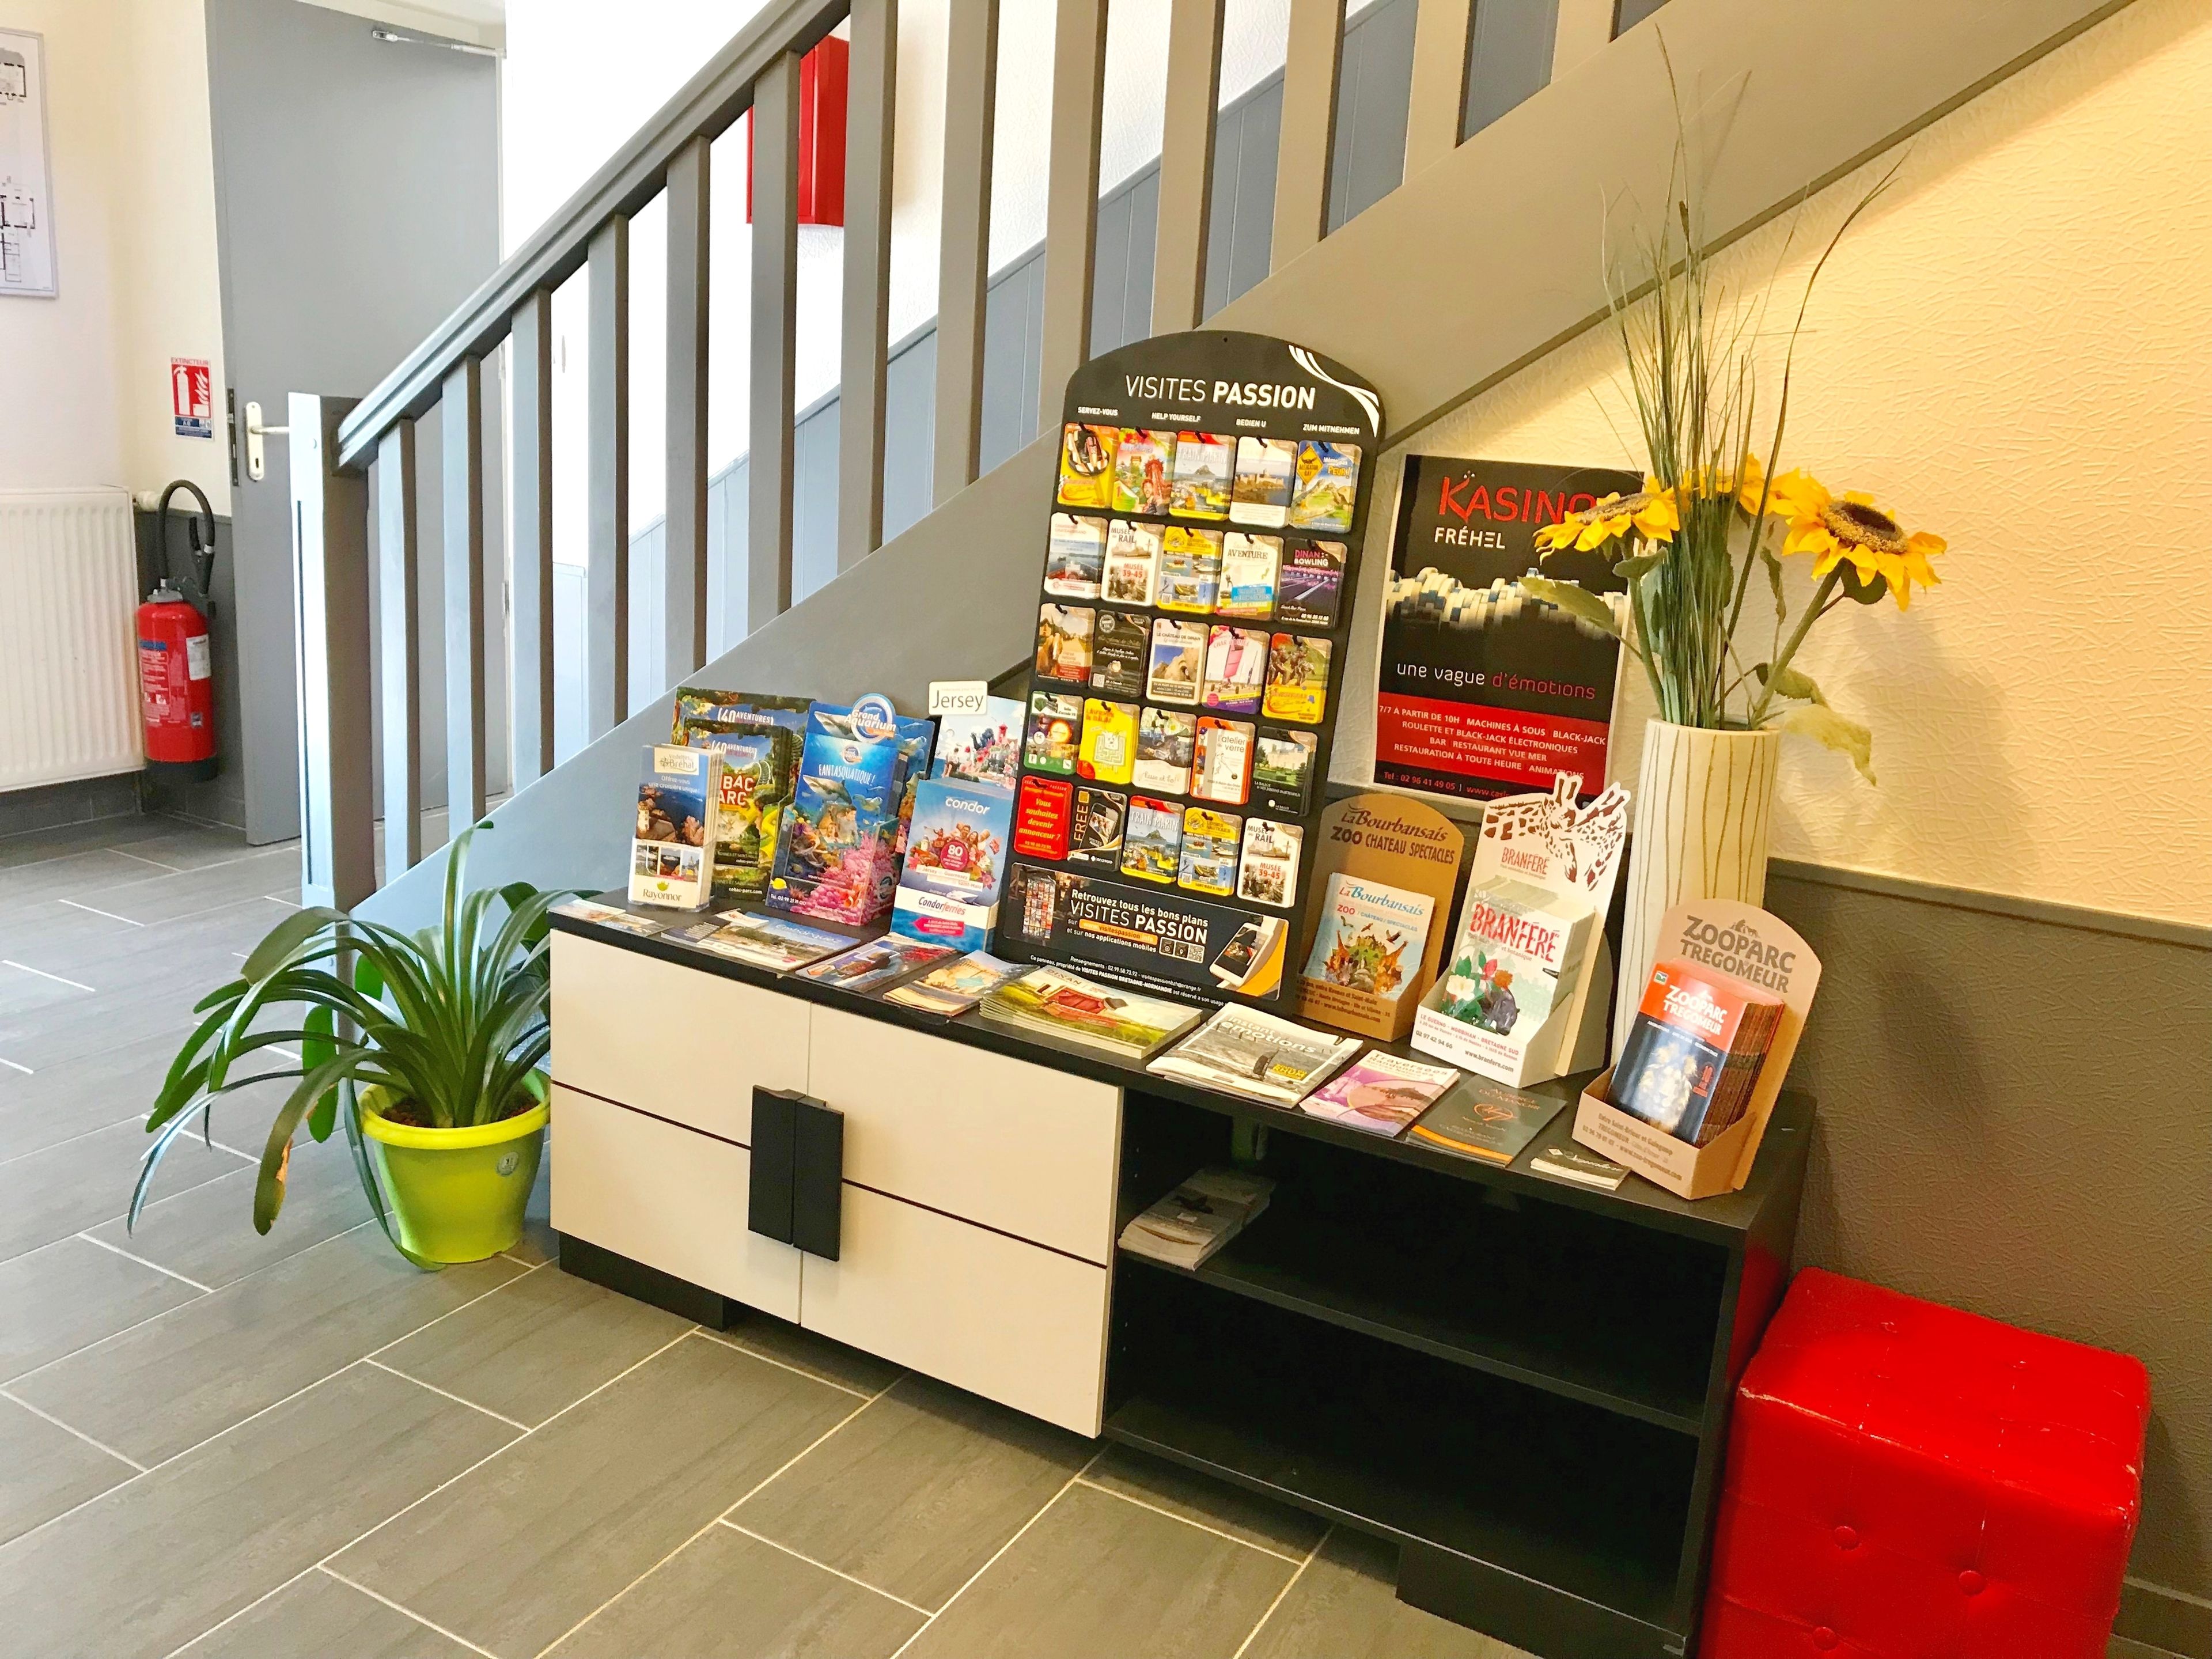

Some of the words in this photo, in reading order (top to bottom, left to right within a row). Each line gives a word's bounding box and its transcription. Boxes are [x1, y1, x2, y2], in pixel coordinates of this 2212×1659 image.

[171, 357, 209, 365] EXTINCTEUR
[1126, 374, 1206, 402] VISITES
[1213, 381, 1316, 410] PASSION
[1078, 406, 1118, 416] SERVEZ-VOUS
[1152, 412, 1168, 421] HELP
[1169, 413, 1201, 422] YOURSELF
[1236, 419, 1260, 427] BEDIEN
[1302, 423, 1318, 432] ZUM
[1319, 425, 1360, 435] MITNEHMEN
[1111, 527, 1131, 535] MUSÉE
[1118, 535, 1137, 543] RAIL
[1228, 549, 1268, 559] AVENTURE
[1295, 550, 1320, 558] DINAN
[1123, 562, 1143, 570] MUSÉE
[1294, 558, 1328, 566] BOWLING
[1123, 569, 1143, 578] 39-45
[1397, 662, 1427, 677] une
[1434, 668, 1485, 687] vague
[1492, 672, 1596, 700] d'émotions
[932, 690, 983, 712] Jersey
[852, 709, 880, 720] Grand
[844, 713, 896, 732] Aquarium
[1379, 705, 1392, 714] 7/7
[1402, 709, 1429, 719] PARTIR
[1431, 713, 1442, 721] DE
[1445, 715, 1460, 724] 10H
[1467, 718, 1510, 732] MACHINES
[1522, 726, 1546, 736] SOUS
[1553, 730, 1606, 745] BLACK-JACK
[1402, 721, 1442, 733] ROULETTE
[1456, 729, 1506, 743] BLACK-JACK
[1509, 736, 1578, 754] ÉLECTRONIQUES
[1225, 744, 1245, 753] verre
[1430, 737, 1446, 746] BAR
[1453, 741, 1506, 755] RESTAURANT
[1509, 749, 1525, 759] VUE
[1528, 752, 1547, 762] MER
[1394, 744, 1455, 759] RESTAURATION
[1465, 754, 1491, 765] TOUTE
[1494, 759, 1522, 770] HEURE
[723, 775, 754, 791] BAC
[719, 790, 747, 805] ARC
[1036, 798, 1051, 807] Vous
[945, 798, 990, 815] condor
[1025, 808, 1058, 819] souhaitez
[1028, 818, 1054, 829] devenir
[1074, 804, 1089, 842] FREE
[1131, 810, 1152, 825] TRAIN
[1155, 816, 1178, 831] MARIN
[1341, 812, 1354, 823] La
[1355, 809, 1448, 842] Bourbansais
[1018, 827, 1056, 839] annonceur
[1255, 833, 1272, 843] RAIL
[948, 844, 963, 857] 80
[1330, 825, 1362, 844] ZOO
[1365, 834, 1407, 854] CHATEAU
[1409, 841, 1455, 864] SPECTACLES
[1259, 869, 1280, 879] 39-45
[1260, 862, 1281, 872] MUSÉE
[643, 889, 682, 902] Rayonnor
[1339, 887, 1350, 896] La
[1350, 885, 1425, 916] Bourbansais
[918, 896, 966, 915] Condorferries
[1072, 889, 1117, 907] Retrouvez
[1119, 899, 1139, 912] tous
[1142, 904, 1156, 915] les
[1157, 907, 1180, 921] bons
[1182, 914, 1208, 927] plans
[1070, 900, 1130, 926] VISITES
[1135, 914, 1207, 944] PASSION
[1337, 904, 1355, 915] ZOO
[1387, 919, 1418, 932] SPECTACLES
[1470, 903, 1560, 963] BRANFÉRÉ
[1096, 934, 1131, 948] applications
[1133, 942, 1157, 953] mobiles
[1683, 915, 1796, 974] ZOOPARC
[1508, 948, 1532, 961] botanique
[1070, 956, 1105, 969] Renseignements
[1680, 938, 1789, 993] TREGOMEUR
[1046, 969, 1082, 984] DINAN
[1056, 961, 1075, 971] propriété
[1081, 967, 1098, 976] VISITES
[1099, 969, 1119, 980] PASSION
[1119, 976, 1172, 993] BRETAGNE-NORMANDIE
[1665, 985, 1728, 1024] ZOOPARC
[1663, 999, 1722, 1036] TREGOMEUR
[1427, 1016, 1446, 1028] GUERNO
[1450, 1027, 1476, 1039] MORBIHAN
[1481, 1038, 1507, 1051] BRETAGNE
[1509, 1047, 1519, 1055] SUD
[1464, 1050, 1514, 1072] www.branfere.com
[1272, 1066, 1306, 1079] RHUM
